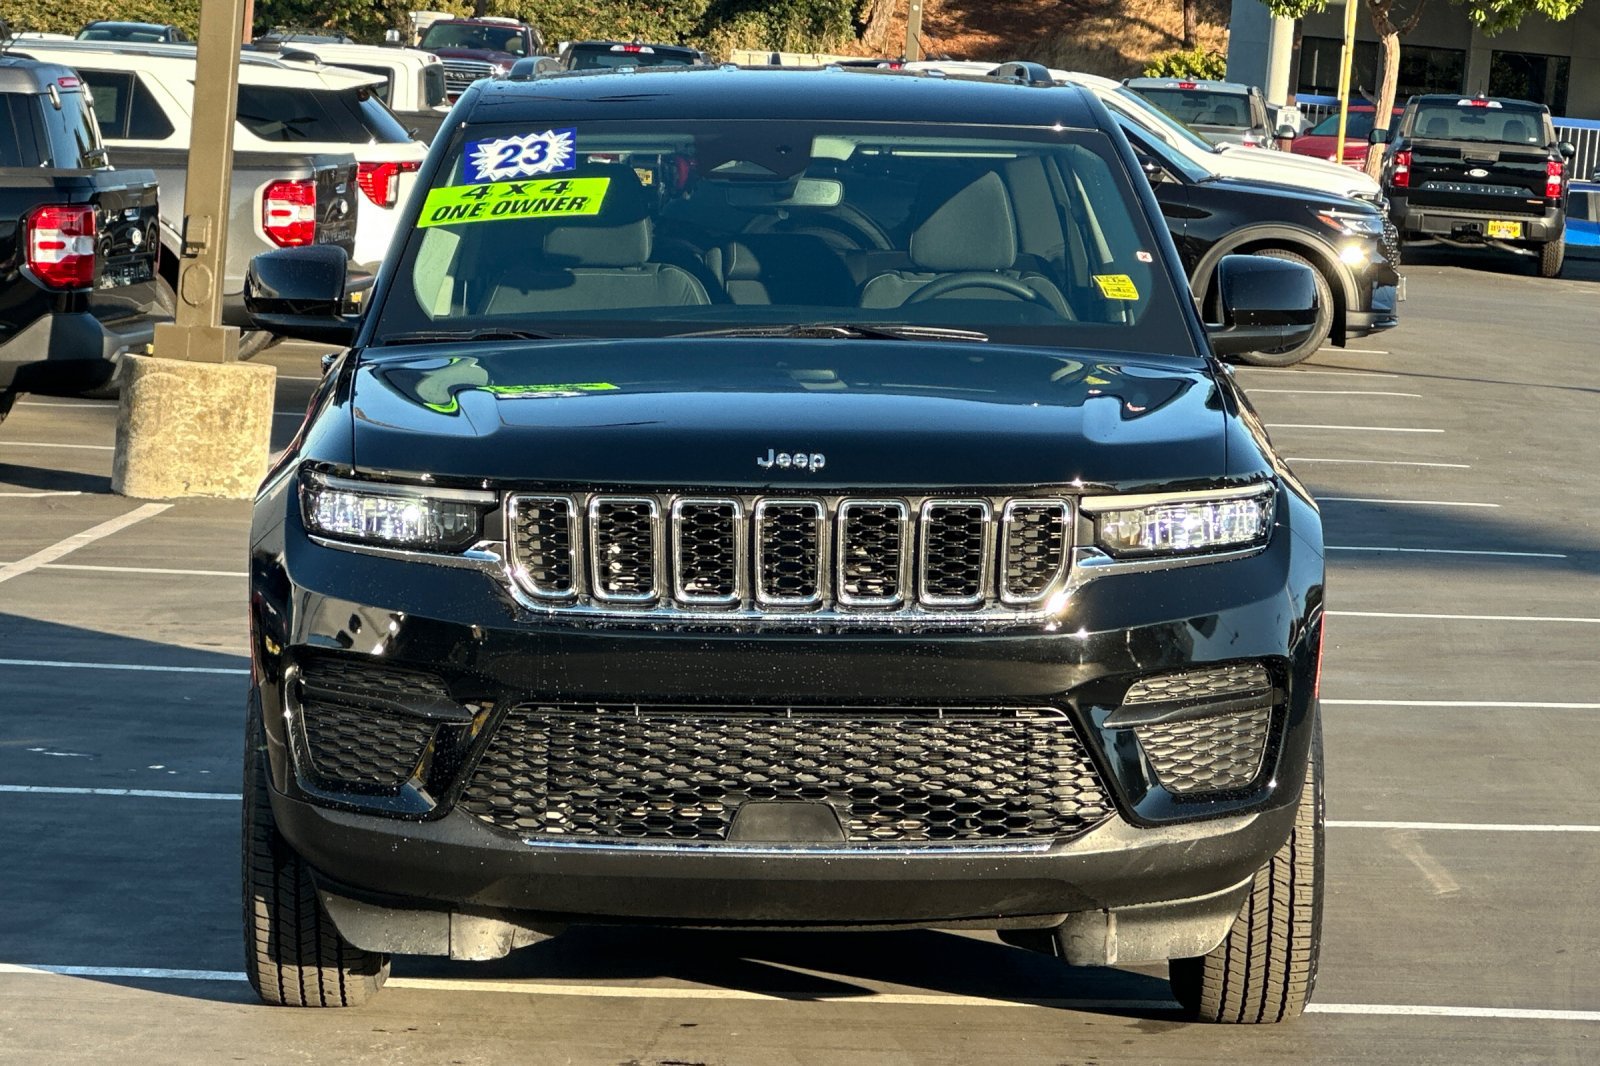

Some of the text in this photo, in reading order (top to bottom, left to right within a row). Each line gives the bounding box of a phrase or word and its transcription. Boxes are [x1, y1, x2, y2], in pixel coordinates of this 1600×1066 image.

[493, 140, 551, 171] 23
[461, 184, 491, 200] 4
[541, 180, 572, 195] 4
[430, 196, 587, 222] ONE OWNER
[757, 448, 826, 472] Jeep
